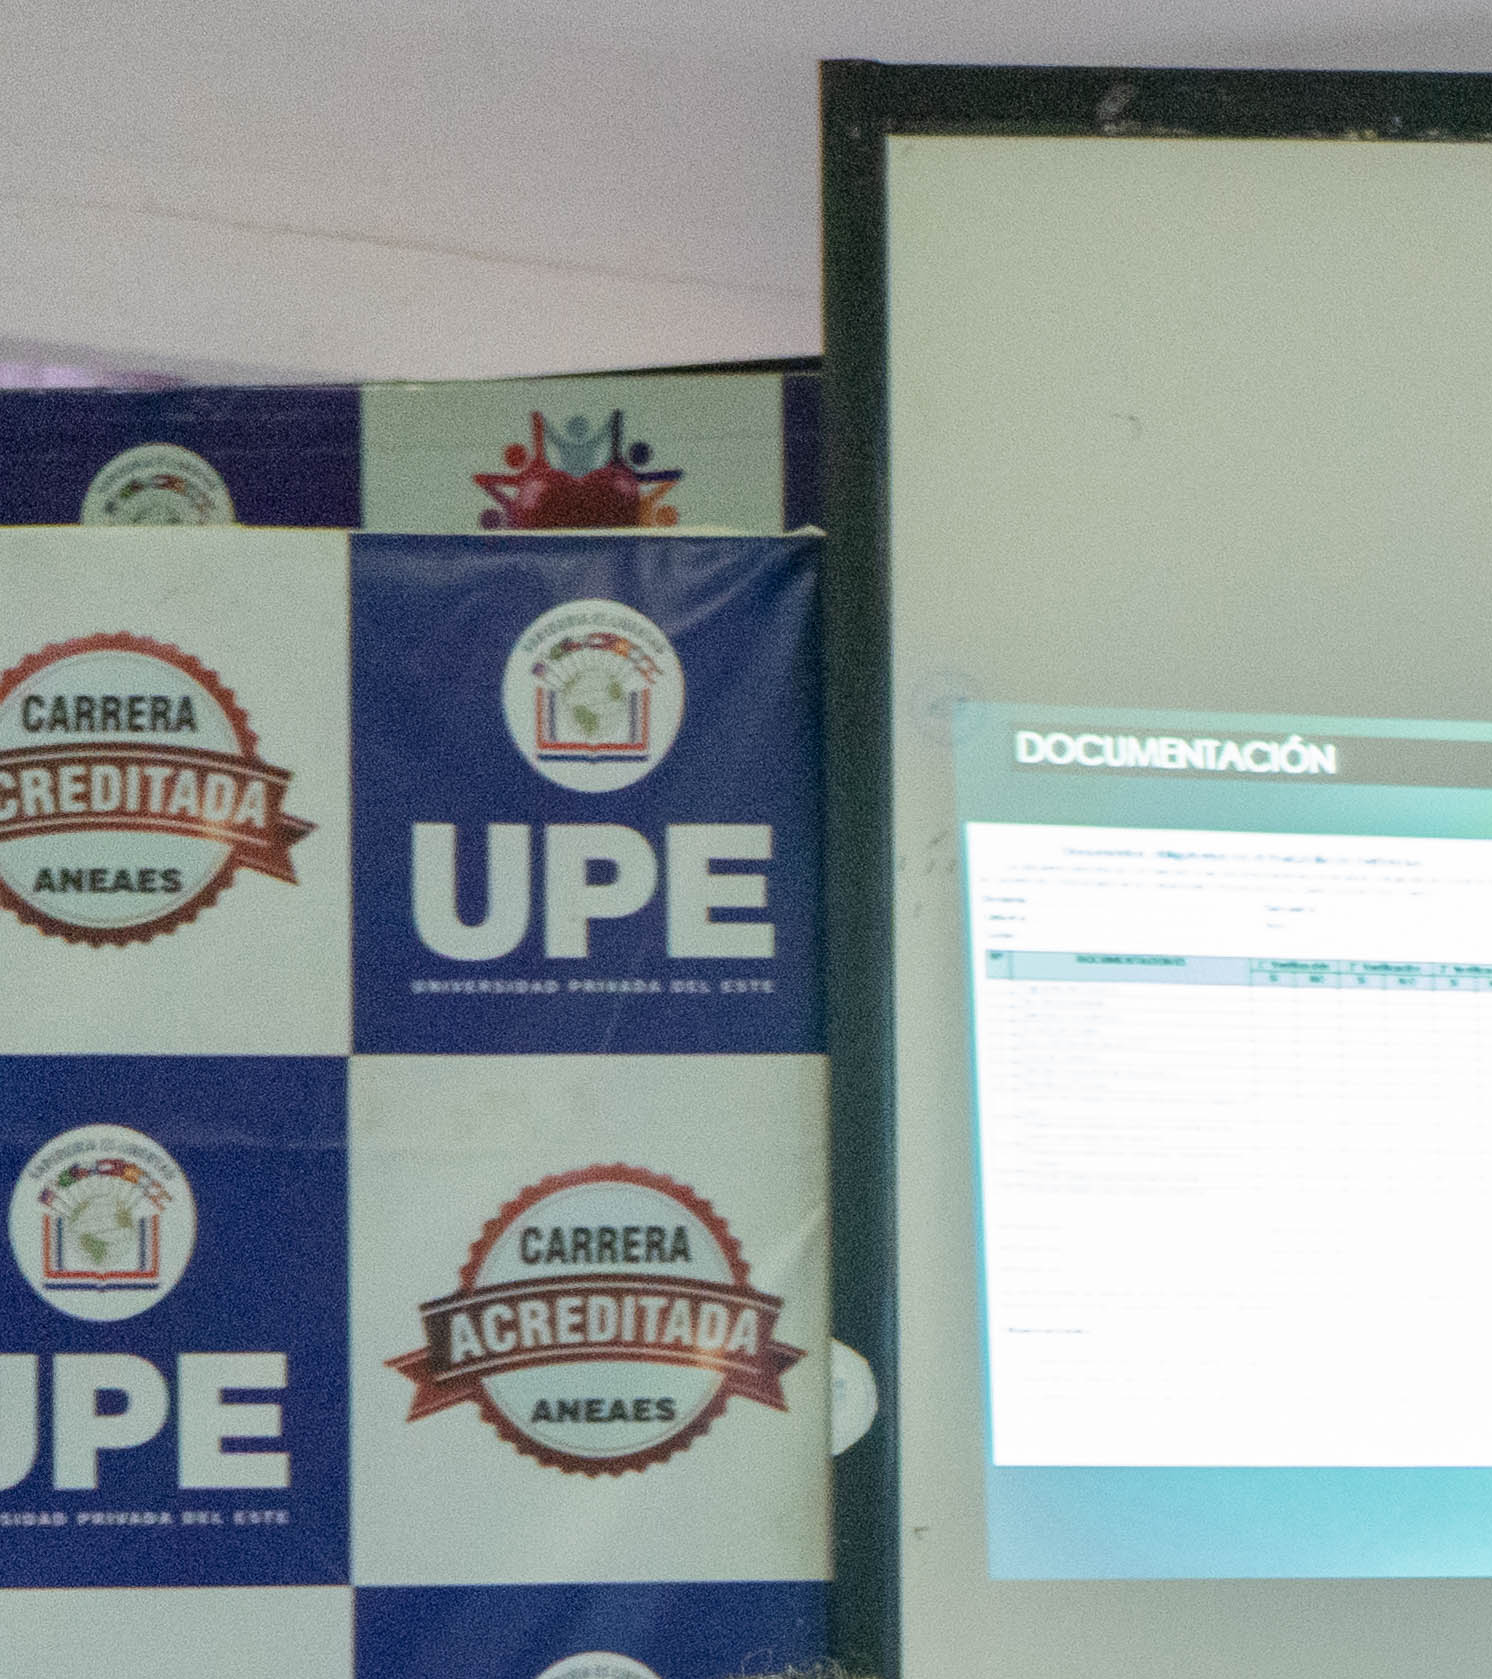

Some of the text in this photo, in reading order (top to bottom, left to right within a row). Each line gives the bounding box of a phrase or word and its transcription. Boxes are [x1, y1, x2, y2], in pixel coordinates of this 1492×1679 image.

[21, 694, 199, 733] CARRERA
[1015, 730, 1337, 774] DOCUMENTACIÓN
[33, 867, 183, 893] ANEAES
[411, 822, 776, 960] UPE
[411, 979, 557, 994] UNIVERSIDAD
[567, 979, 661, 994] PRIVADA
[519, 1225, 692, 1265] CARRERA
[451, 1296, 760, 1362] ACREDITADA
[531, 1397, 677, 1423] ANEAES
[77, 1511, 172, 1526] PRIVADA
